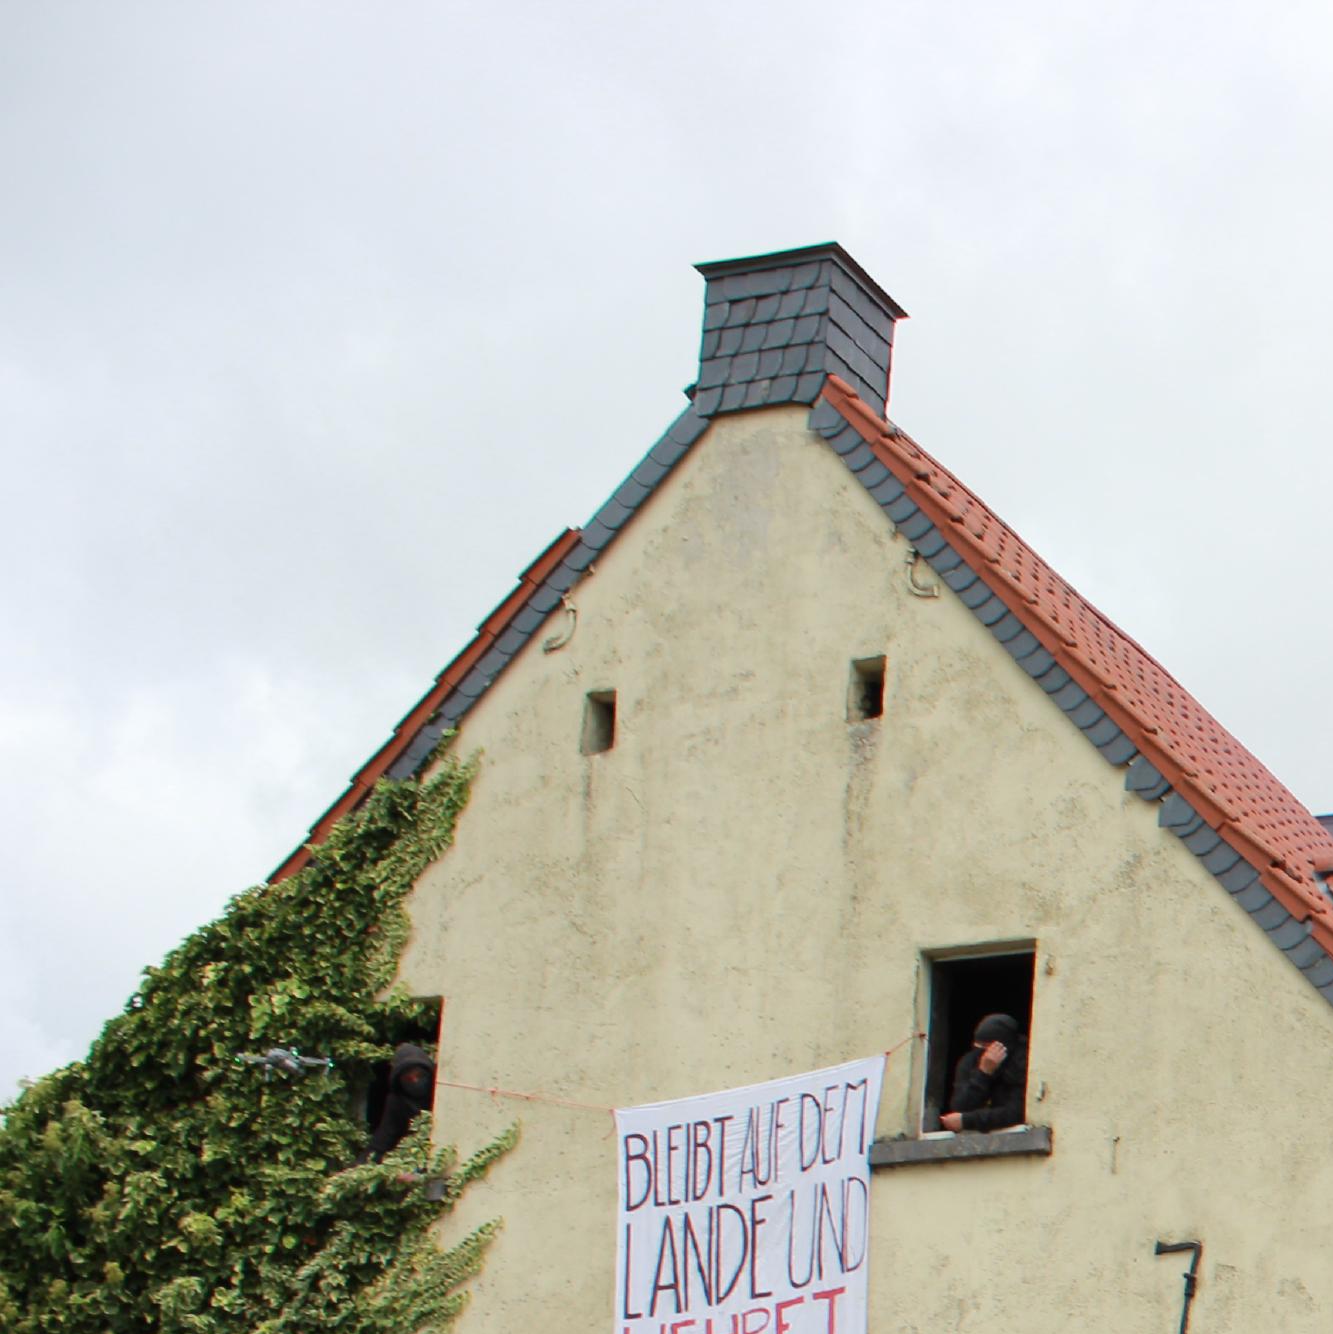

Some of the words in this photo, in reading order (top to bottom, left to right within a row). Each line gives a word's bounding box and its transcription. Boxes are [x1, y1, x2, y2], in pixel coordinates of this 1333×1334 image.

[624, 1116, 733, 1211] BLEIBT
[739, 1096, 790, 1195] AUF
[800, 1078, 868, 1172] DEM
[624, 1194, 773, 1320] LANDE
[789, 1175, 868, 1288] UND
